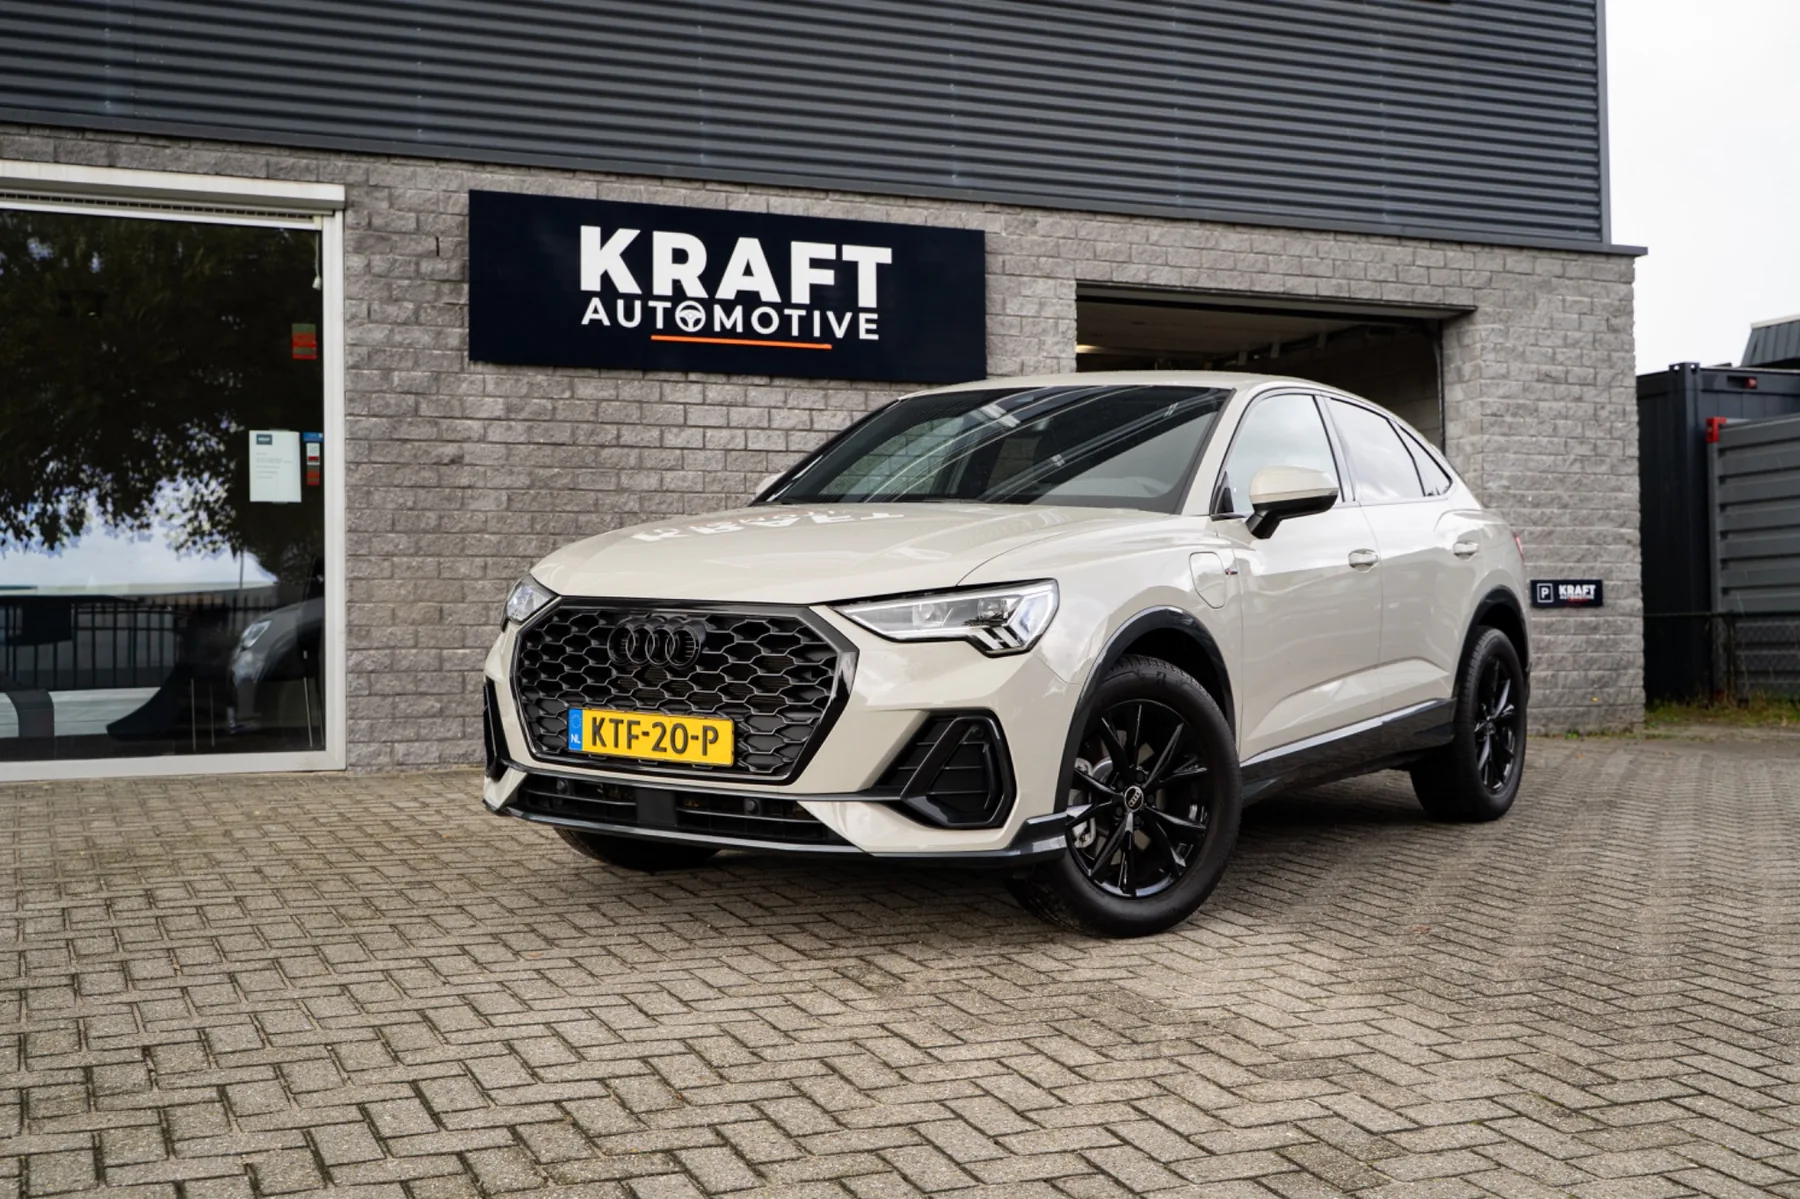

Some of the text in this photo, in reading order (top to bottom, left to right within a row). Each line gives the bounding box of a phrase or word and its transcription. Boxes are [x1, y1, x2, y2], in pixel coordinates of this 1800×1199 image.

[580, 225, 892, 308] KRAFT
[581, 297, 880, 340] AUTOMOTIVE
[1541, 587, 1549, 599] P
[1558, 584, 1596, 596] KRAFT
[570, 734, 581, 744] NL
[592, 717, 718, 756] KTF-20-P
